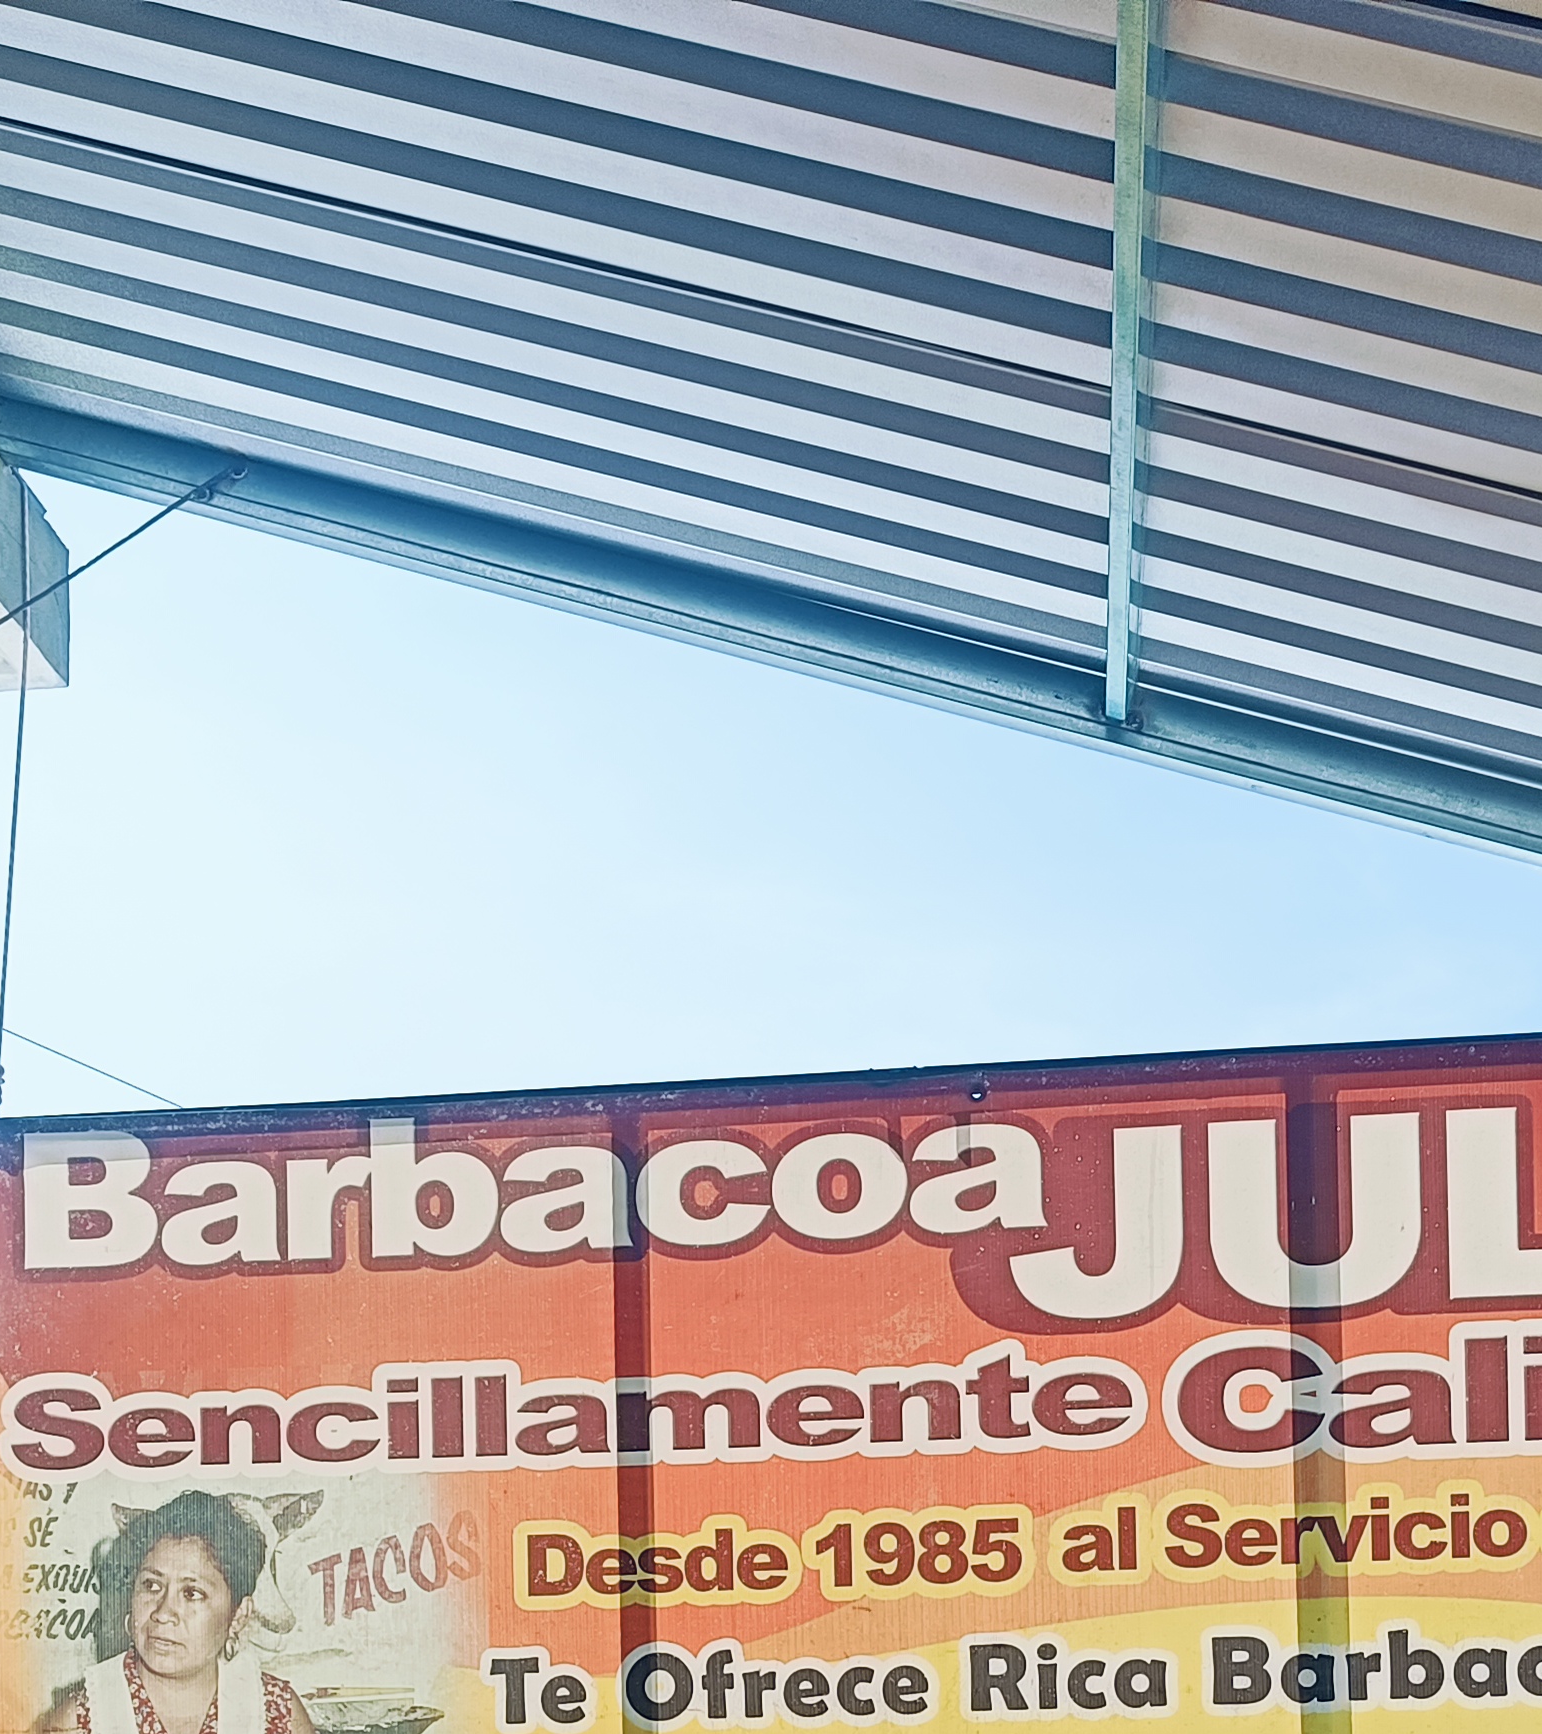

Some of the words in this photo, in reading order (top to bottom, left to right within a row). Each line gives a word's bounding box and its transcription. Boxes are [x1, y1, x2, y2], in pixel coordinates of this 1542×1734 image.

[23, 1117, 1048, 1269] Barbacoa
[11, 1354, 1133, 1470] Sencillamente
[307, 1510, 481, 1626] TACOS
[526, 1529, 789, 1597] Desde
[815, 1517, 1022, 1588] 1985
[1062, 1507, 1137, 1572] al
[1164, 1494, 1527, 1568] Servicio
[490, 1657, 586, 1725] Te
[624, 1649, 929, 1722] Ofrece
[969, 1643, 1168, 1711] Rica
